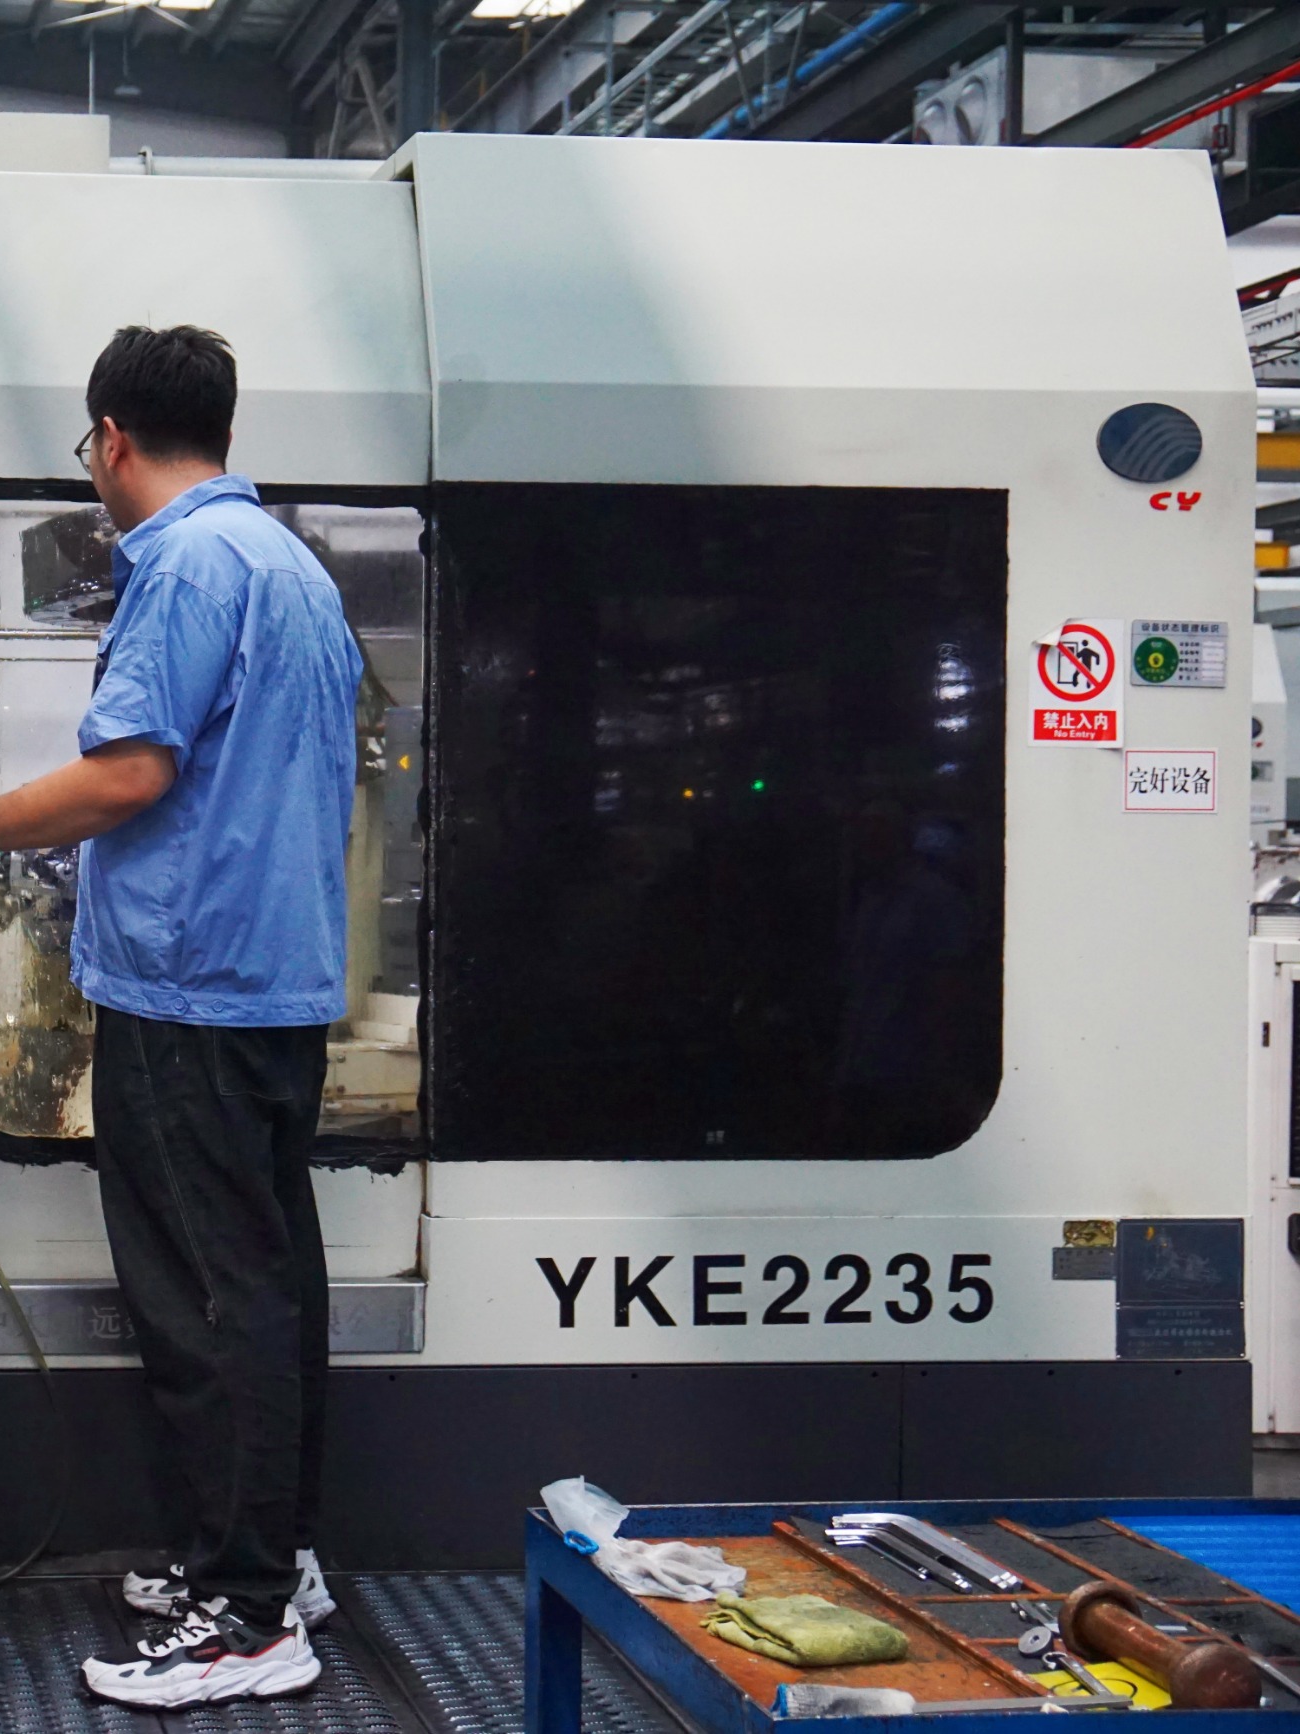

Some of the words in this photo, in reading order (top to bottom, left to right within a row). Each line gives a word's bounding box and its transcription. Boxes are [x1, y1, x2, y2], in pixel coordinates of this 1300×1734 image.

[1149, 491, 1202, 511] CY
[1043, 711, 1109, 730] 禁止入内
[1053, 729, 1069, 738] No
[1069, 729, 1096, 740] Entry
[1129, 766, 1211, 795] 完好设备
[535, 1253, 995, 1329] YKE2235
